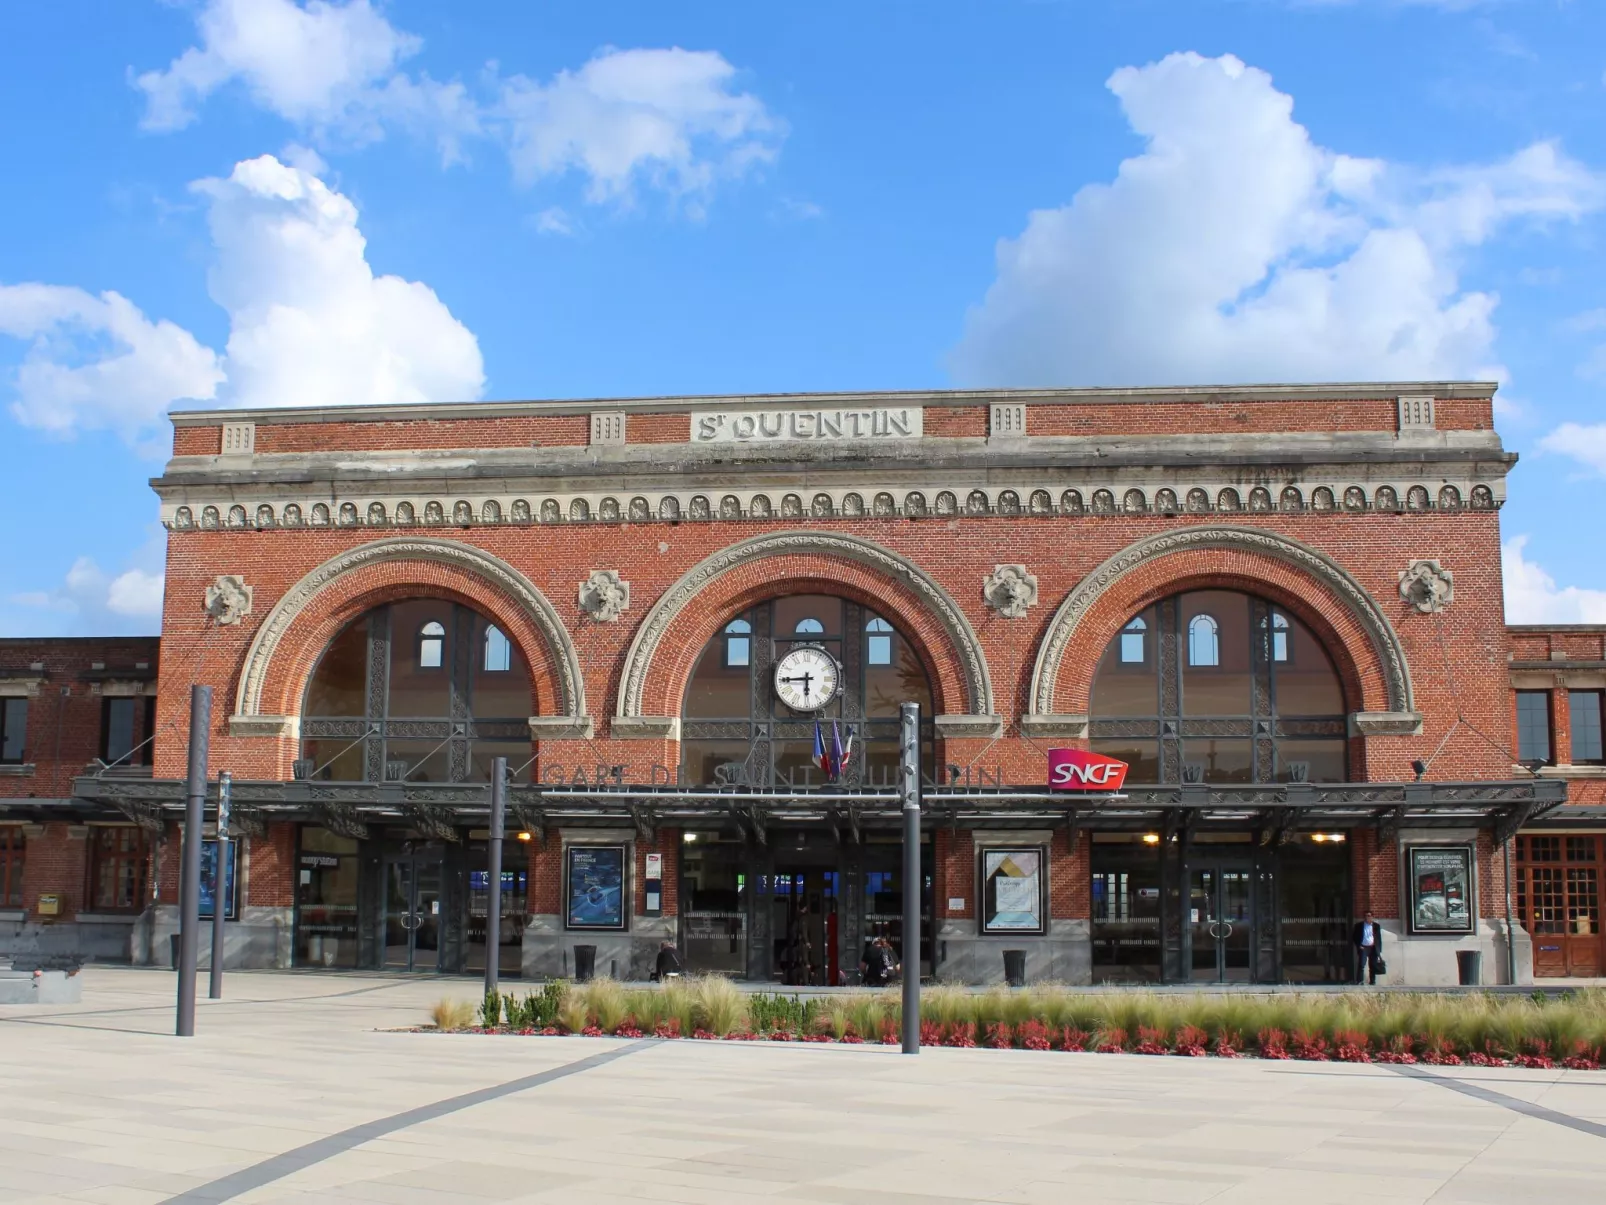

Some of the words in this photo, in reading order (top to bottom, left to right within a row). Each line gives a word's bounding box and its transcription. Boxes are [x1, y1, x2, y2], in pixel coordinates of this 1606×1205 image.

[733, 409, 912, 439] QUENTIN
[543, 764, 629, 787] GARE
[1052, 762, 1124, 785] SNCF
